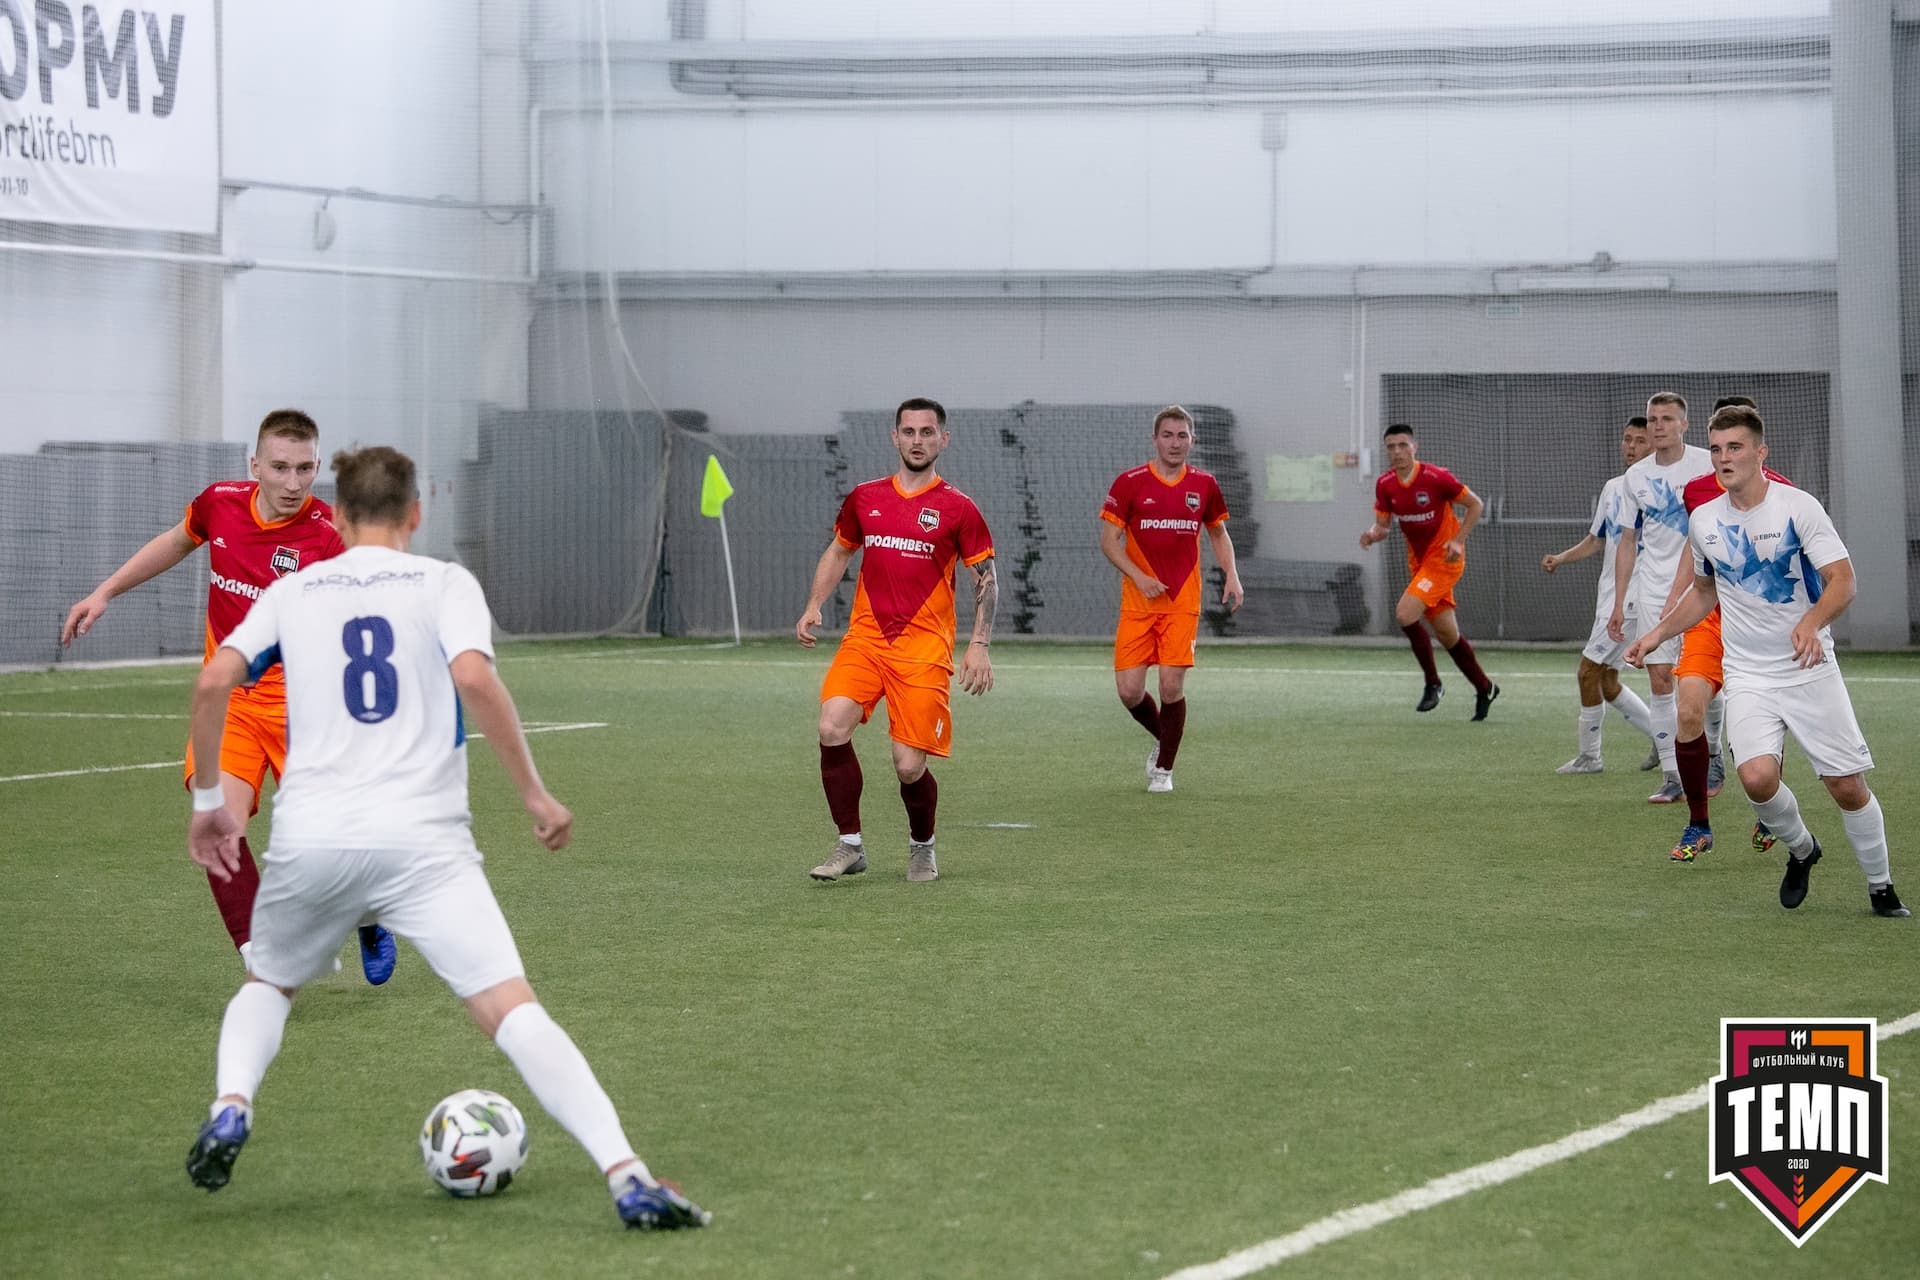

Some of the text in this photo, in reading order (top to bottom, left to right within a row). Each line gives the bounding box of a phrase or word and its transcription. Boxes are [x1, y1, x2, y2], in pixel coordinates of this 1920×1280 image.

[0, 0, 185, 118] ОРМУ
[0, 115, 117, 167] rtlifebrn
[864, 534, 936, 554] ПРОДИНВЕСТ
[1759, 532, 1781, 541] ЕВРАЗ
[274, 554, 298, 571] ТЕМП
[342, 615, 399, 724] 8
[935, 718, 944, 739] 4
